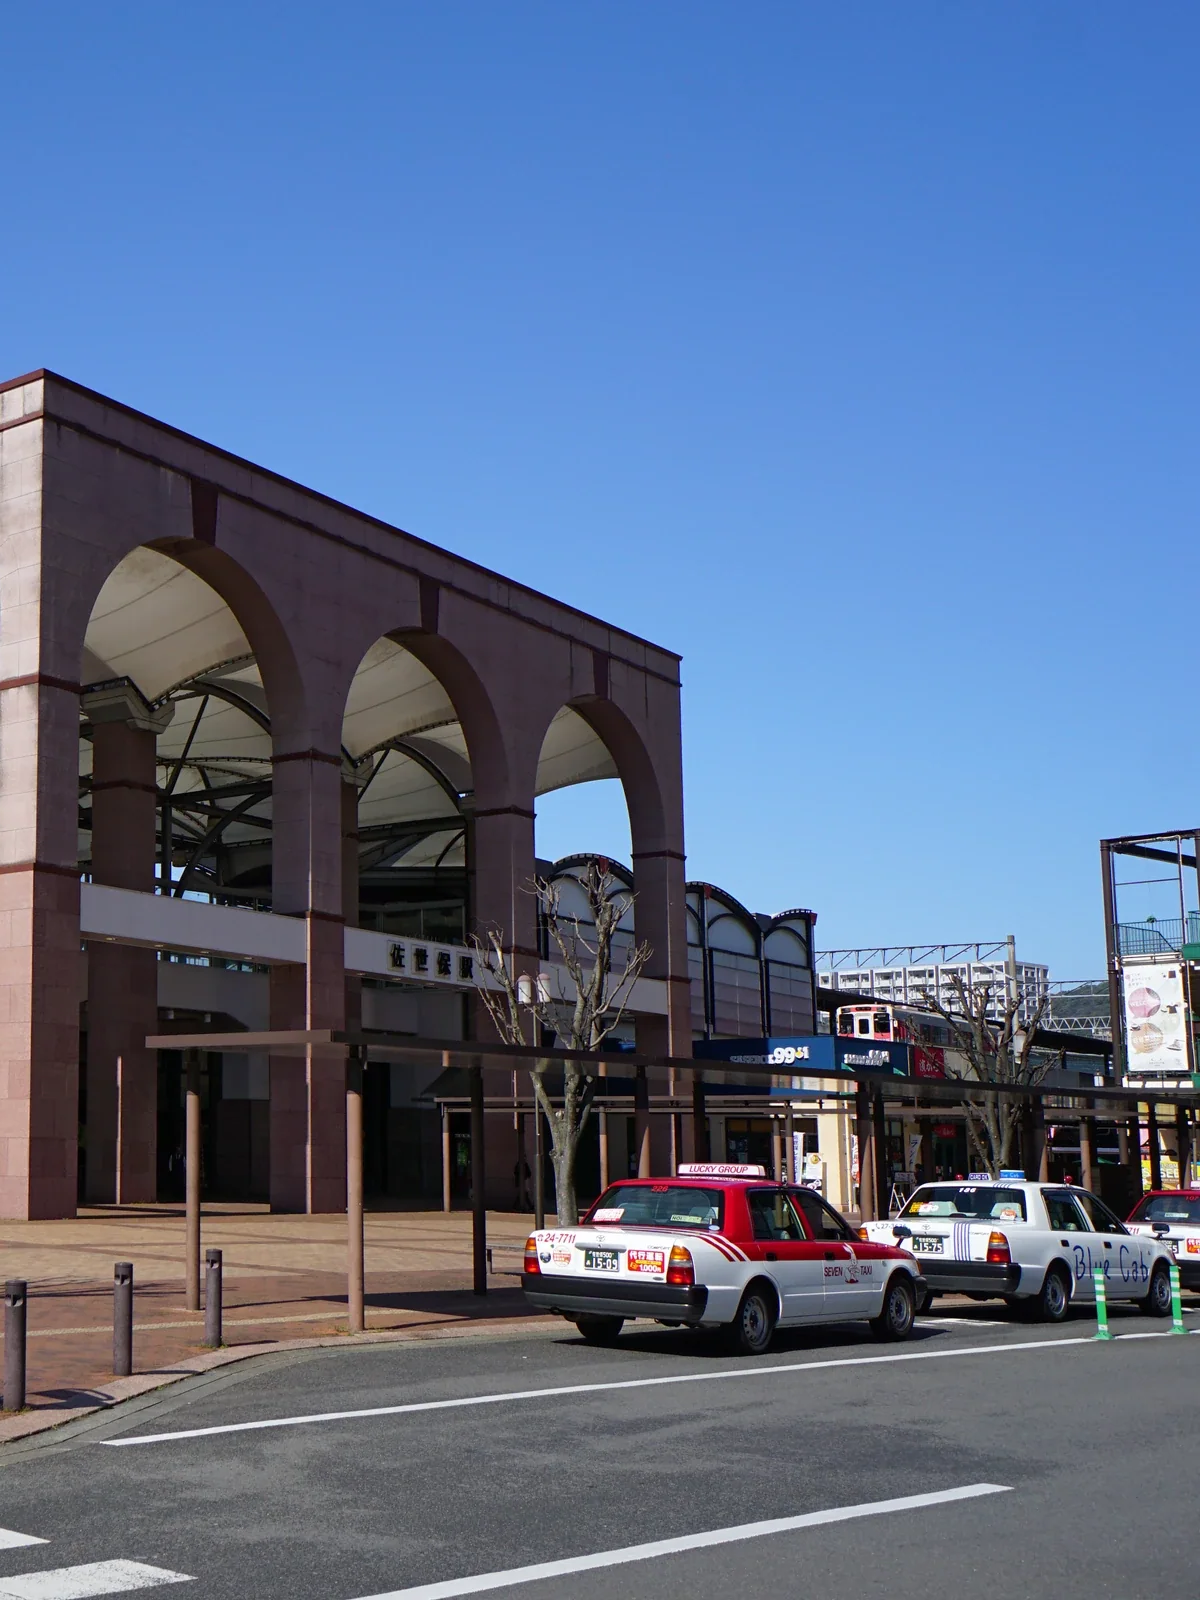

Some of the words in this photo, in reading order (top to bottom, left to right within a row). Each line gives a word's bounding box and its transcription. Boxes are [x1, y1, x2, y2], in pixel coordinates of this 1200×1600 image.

[389, 943, 474, 979] 佐世保駅
[689, 1164, 717, 1174] LUCKY
[718, 1164, 749, 1174] GROUP
[543, 1232, 577, 1244] 24-7711
[919, 1243, 943, 1252] 15-75
[592, 1258, 618, 1270] 15-09
[1119, 1244, 1149, 1283] Cab
[823, 1266, 844, 1277] SEVEN
[859, 1265, 873, 1275] TAXI
